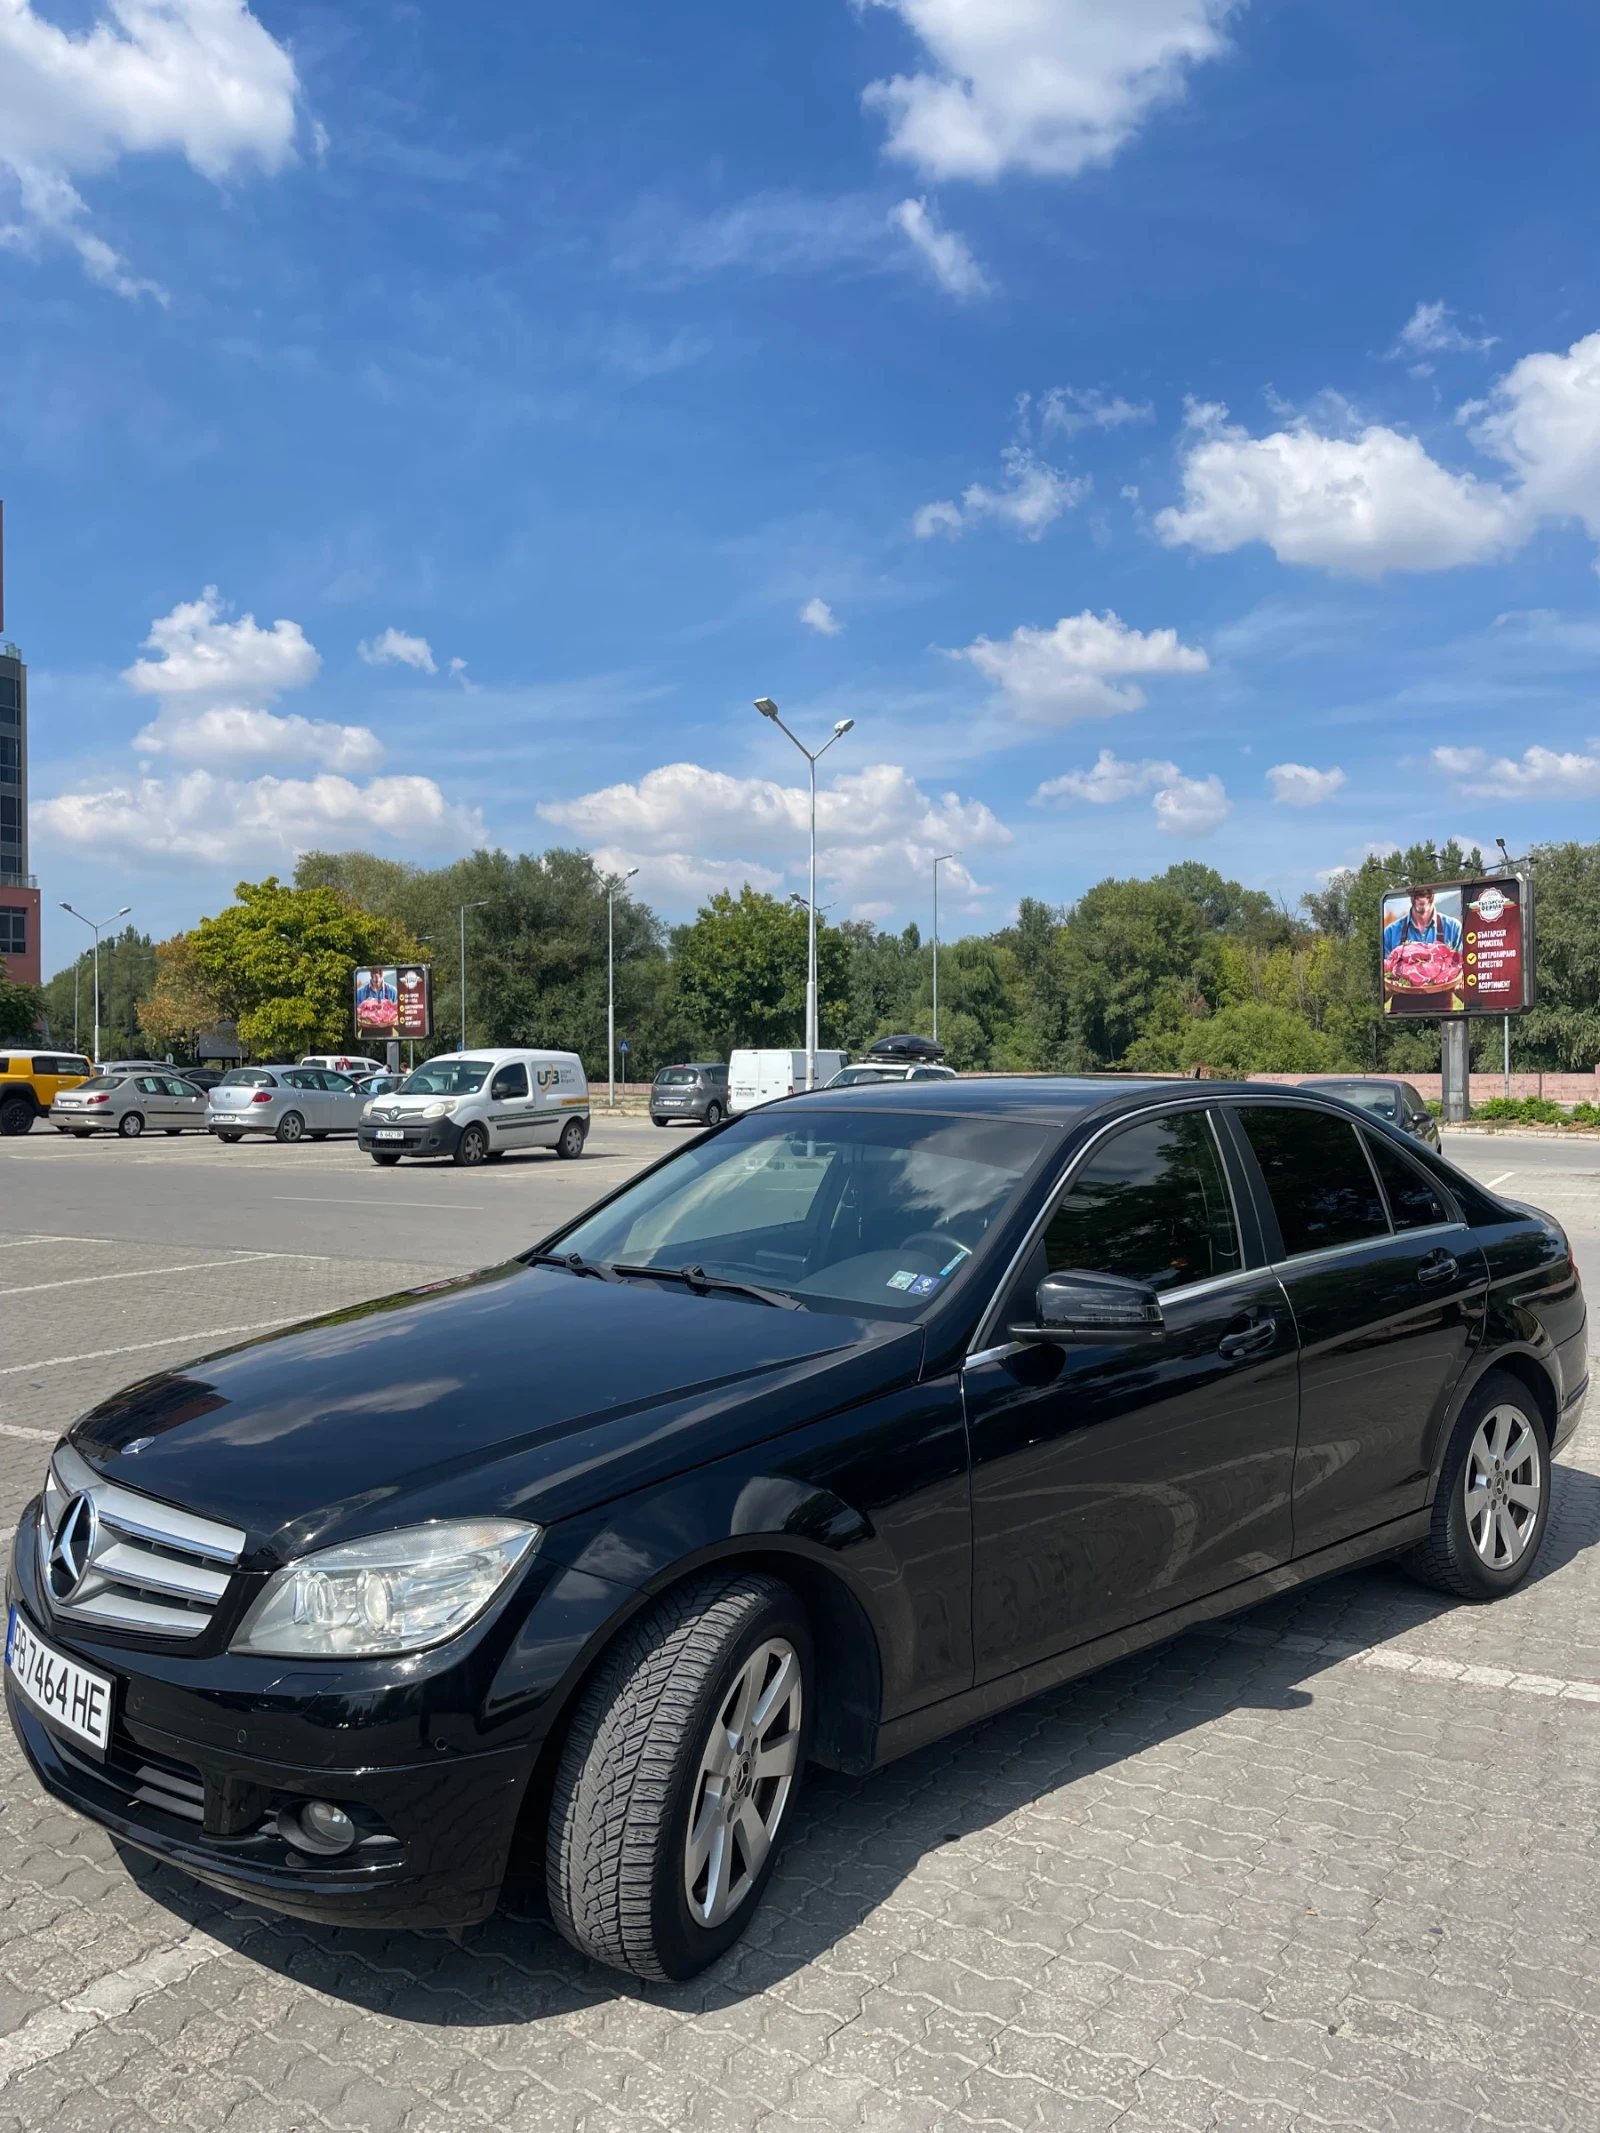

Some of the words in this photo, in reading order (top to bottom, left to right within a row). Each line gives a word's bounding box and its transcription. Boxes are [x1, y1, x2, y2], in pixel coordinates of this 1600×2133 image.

[1477, 929, 1507, 939] БЪЛГАРСКИ
[1477, 939, 1504, 948] ПРОИЗХОД
[1477, 949, 1516, 960] КОНТРОЛИРАНО
[1477, 959, 1503, 969] КАЧЕСТВО
[1477, 972, 1493, 981] БОГАТ
[1478, 980, 1511, 990] АСОРТИМЕНТ
